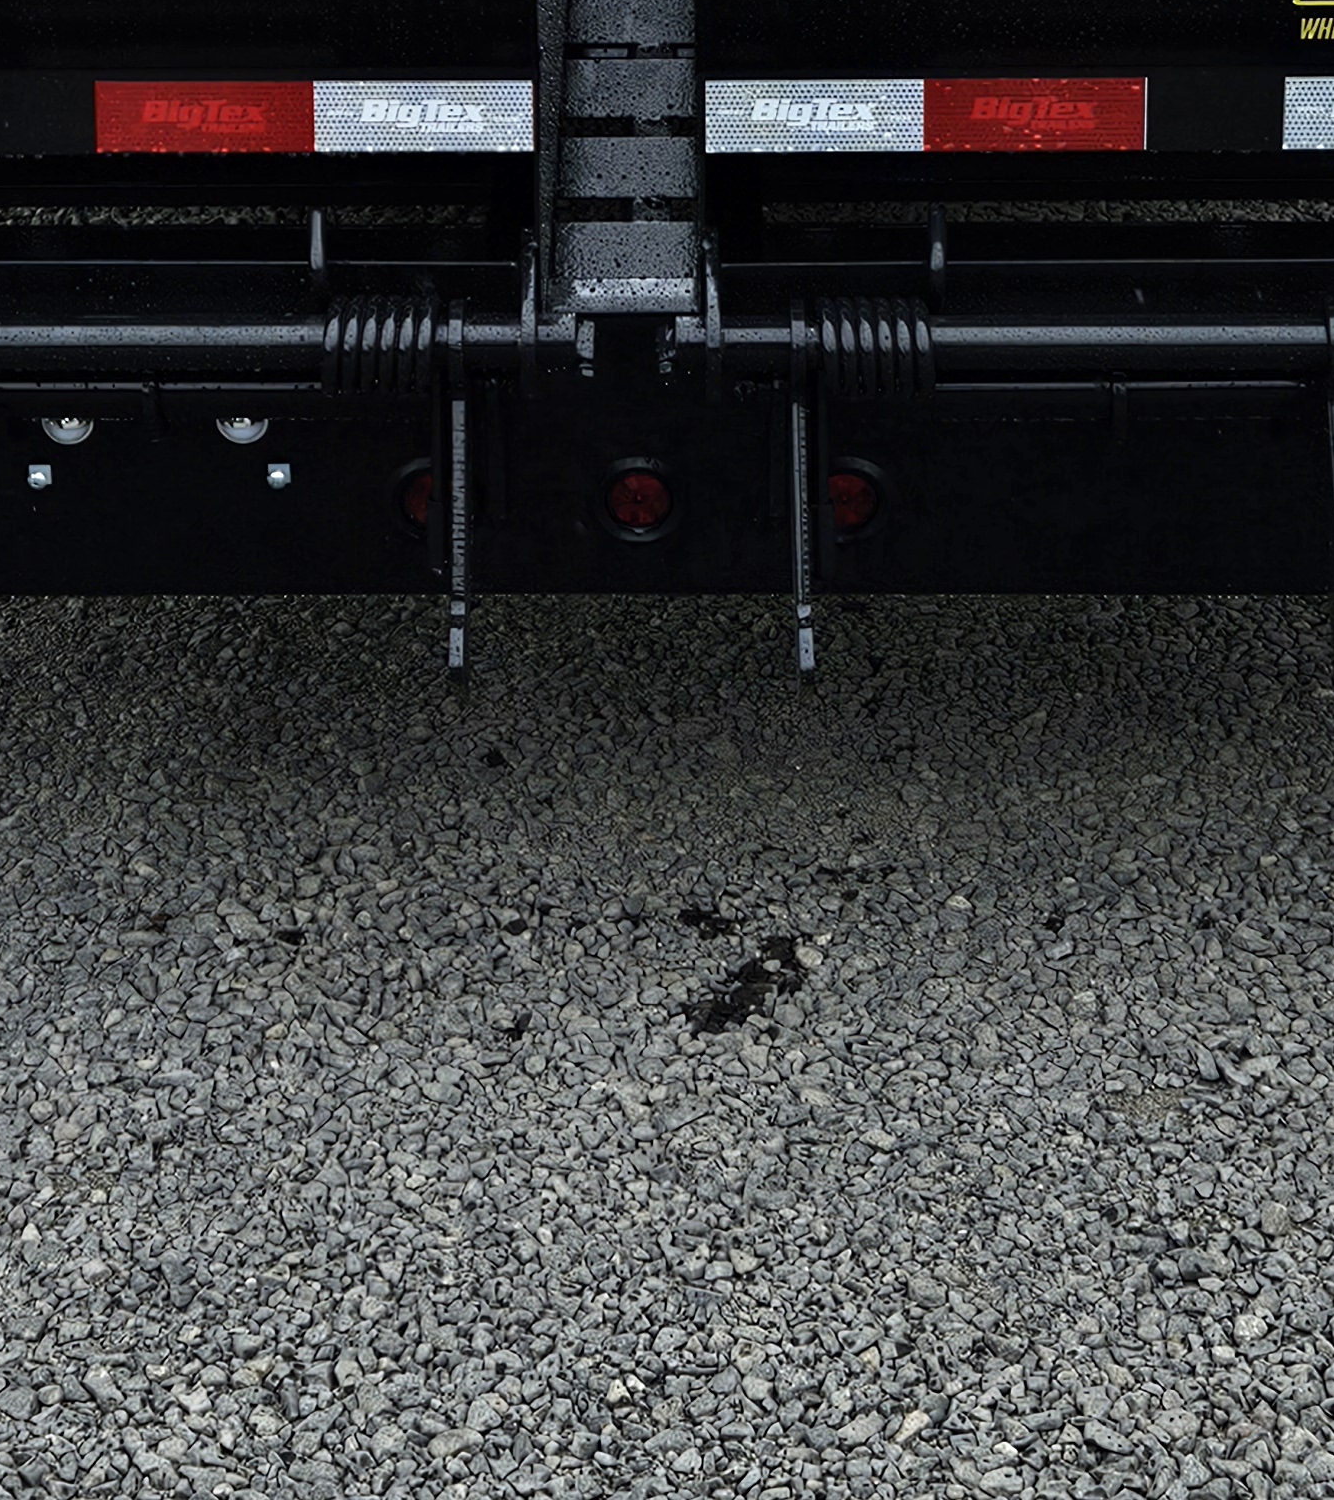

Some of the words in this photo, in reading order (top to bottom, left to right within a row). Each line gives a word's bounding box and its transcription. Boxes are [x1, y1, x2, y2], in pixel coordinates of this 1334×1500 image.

[142, 100, 266, 130] BigTex
[360, 100, 485, 128] BigTex
[751, 99, 875, 127] BigTex
[970, 97, 1097, 125] BigTex
